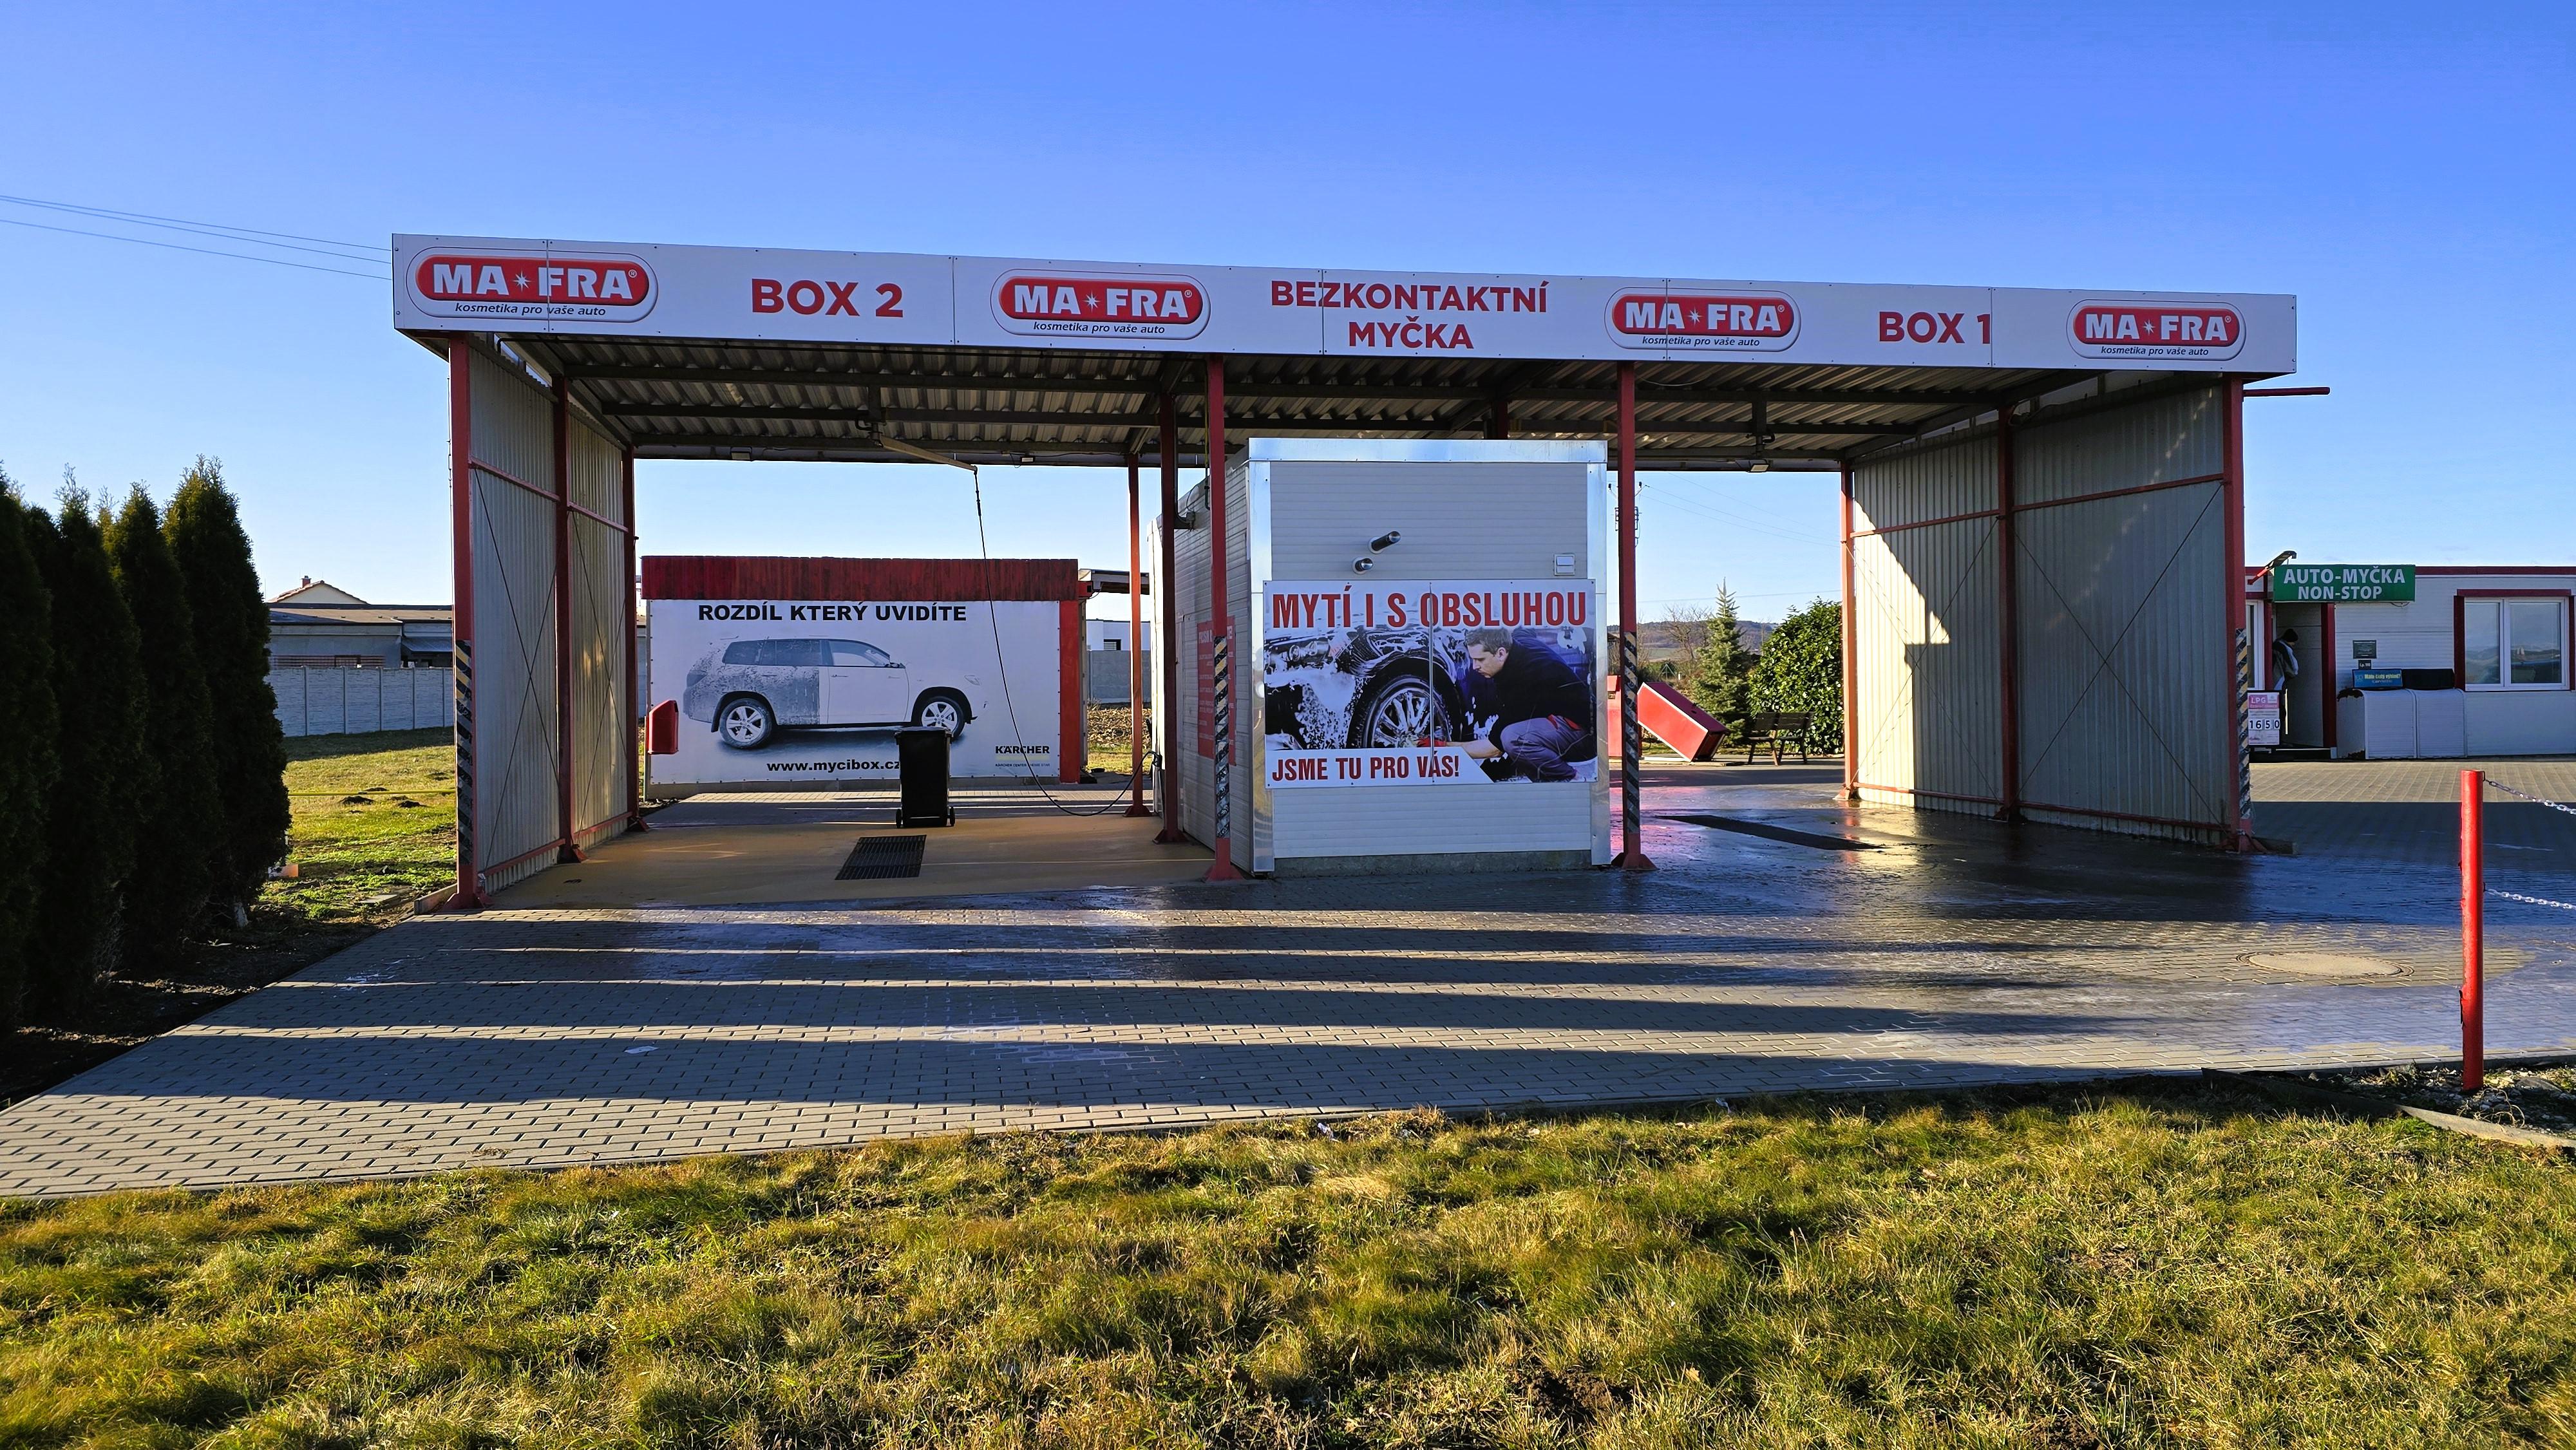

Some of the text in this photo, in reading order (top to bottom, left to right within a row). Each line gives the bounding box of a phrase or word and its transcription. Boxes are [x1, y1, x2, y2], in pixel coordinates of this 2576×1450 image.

[752, 278, 903, 317] BOX 2
[1271, 280, 1549, 313] BEZKONTAKTNÍ
[455, 303, 606, 315] kosmetika pro vaše auto
[1034, 321, 1088, 332] kosmetika
[1092, 325, 1110, 334] pro
[1113, 323, 1137, 333] vaše
[1349, 315, 1474, 349] MYČKA
[1879, 312, 1991, 344] BOX 1
[1642, 336, 1691, 345] kosmetika
[1694, 338, 1710, 346] pro
[1714, 337, 1735, 346] vaše
[2101, 346, 2146, 354] kosmetika
[2166, 347, 2186, 355] vaše
[2284, 566, 2405, 584] AUTO-MYČKA
[2298, 586, 2382, 599] NON-STOP
[699, 601, 967, 621] ROZDÍL KTERÝ UVIDÍTE
[1273, 585, 1587, 628] MYTÍ I S OBSLUHOU
[995, 746, 1050, 754] KÄRCHER
[766, 759, 900, 773] www.mycibox.cz
[1272, 751, 1459, 781] JSME TU PRO VÁS!
